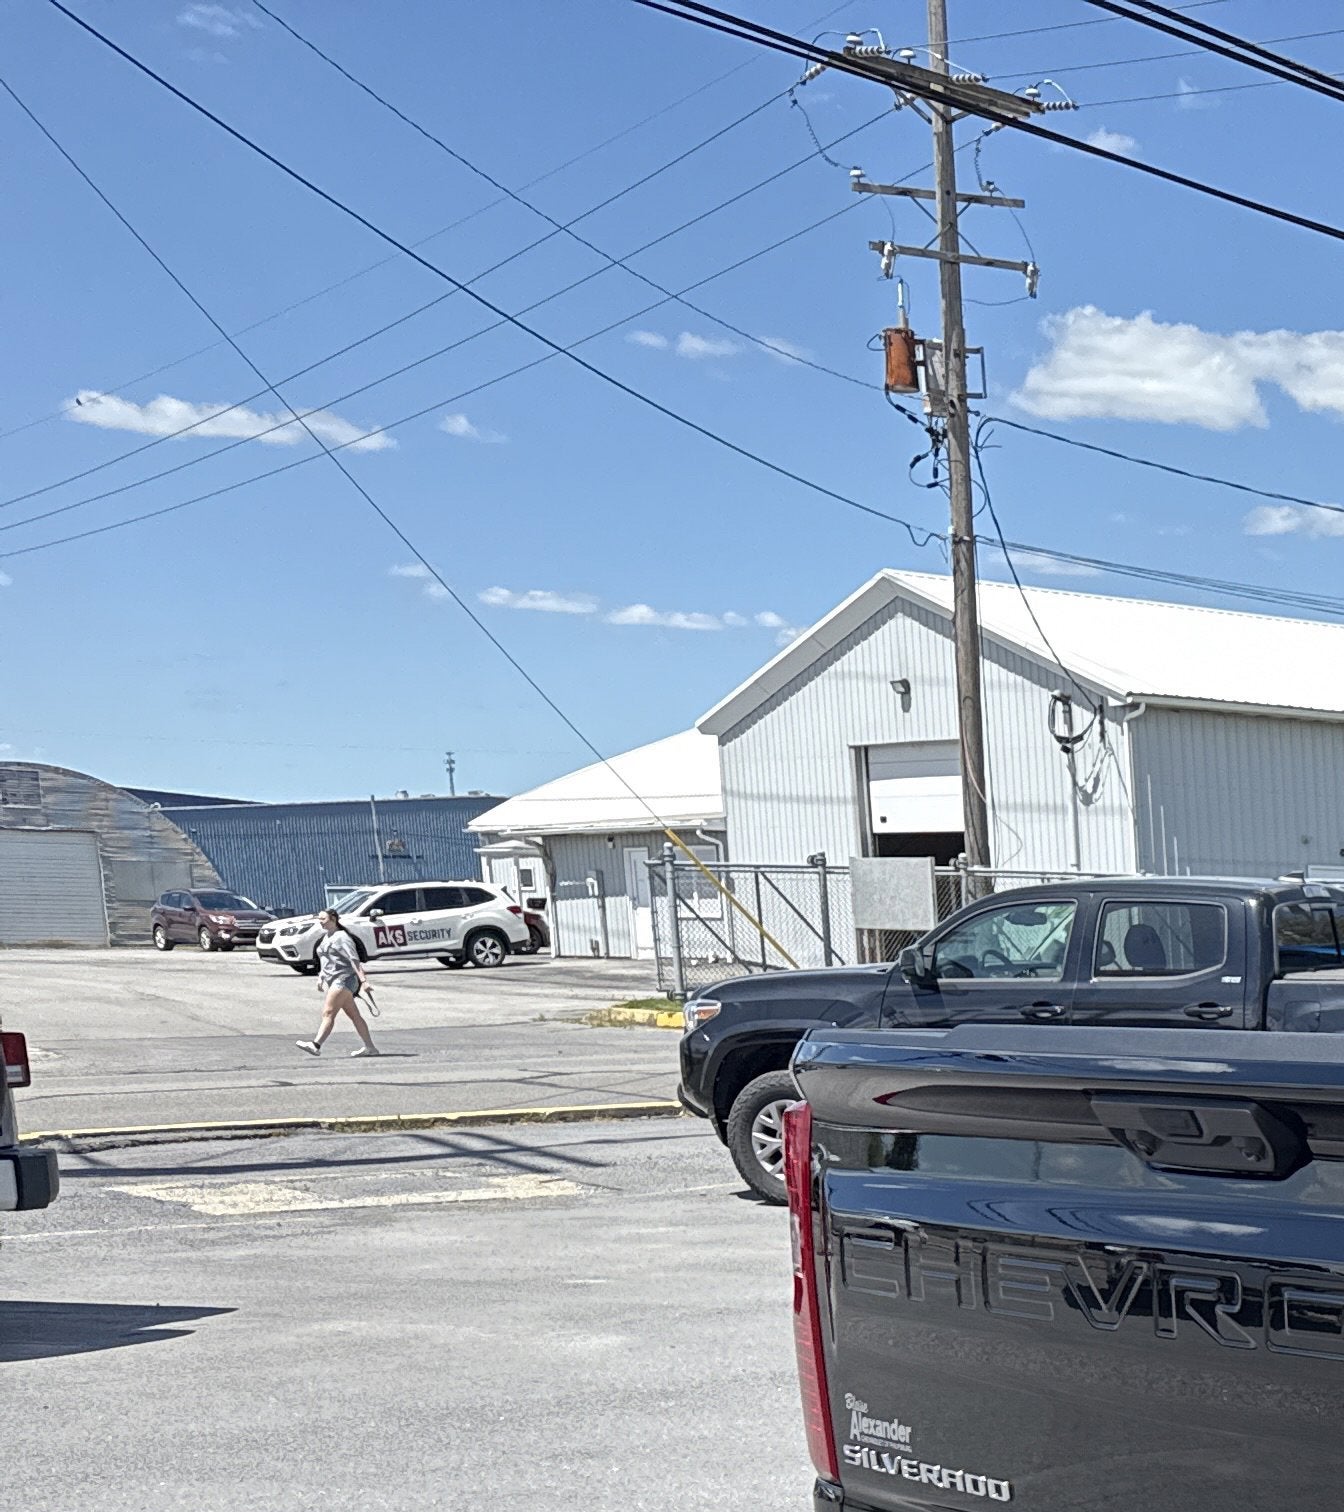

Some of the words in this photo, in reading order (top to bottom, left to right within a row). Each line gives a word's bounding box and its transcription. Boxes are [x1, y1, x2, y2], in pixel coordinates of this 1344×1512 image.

[378, 926, 406, 947] AKS
[407, 928, 452, 941] SECURITY
[850, 1410, 912, 1444] Alexander
[843, 1444, 1013, 1503] SILVERADO
